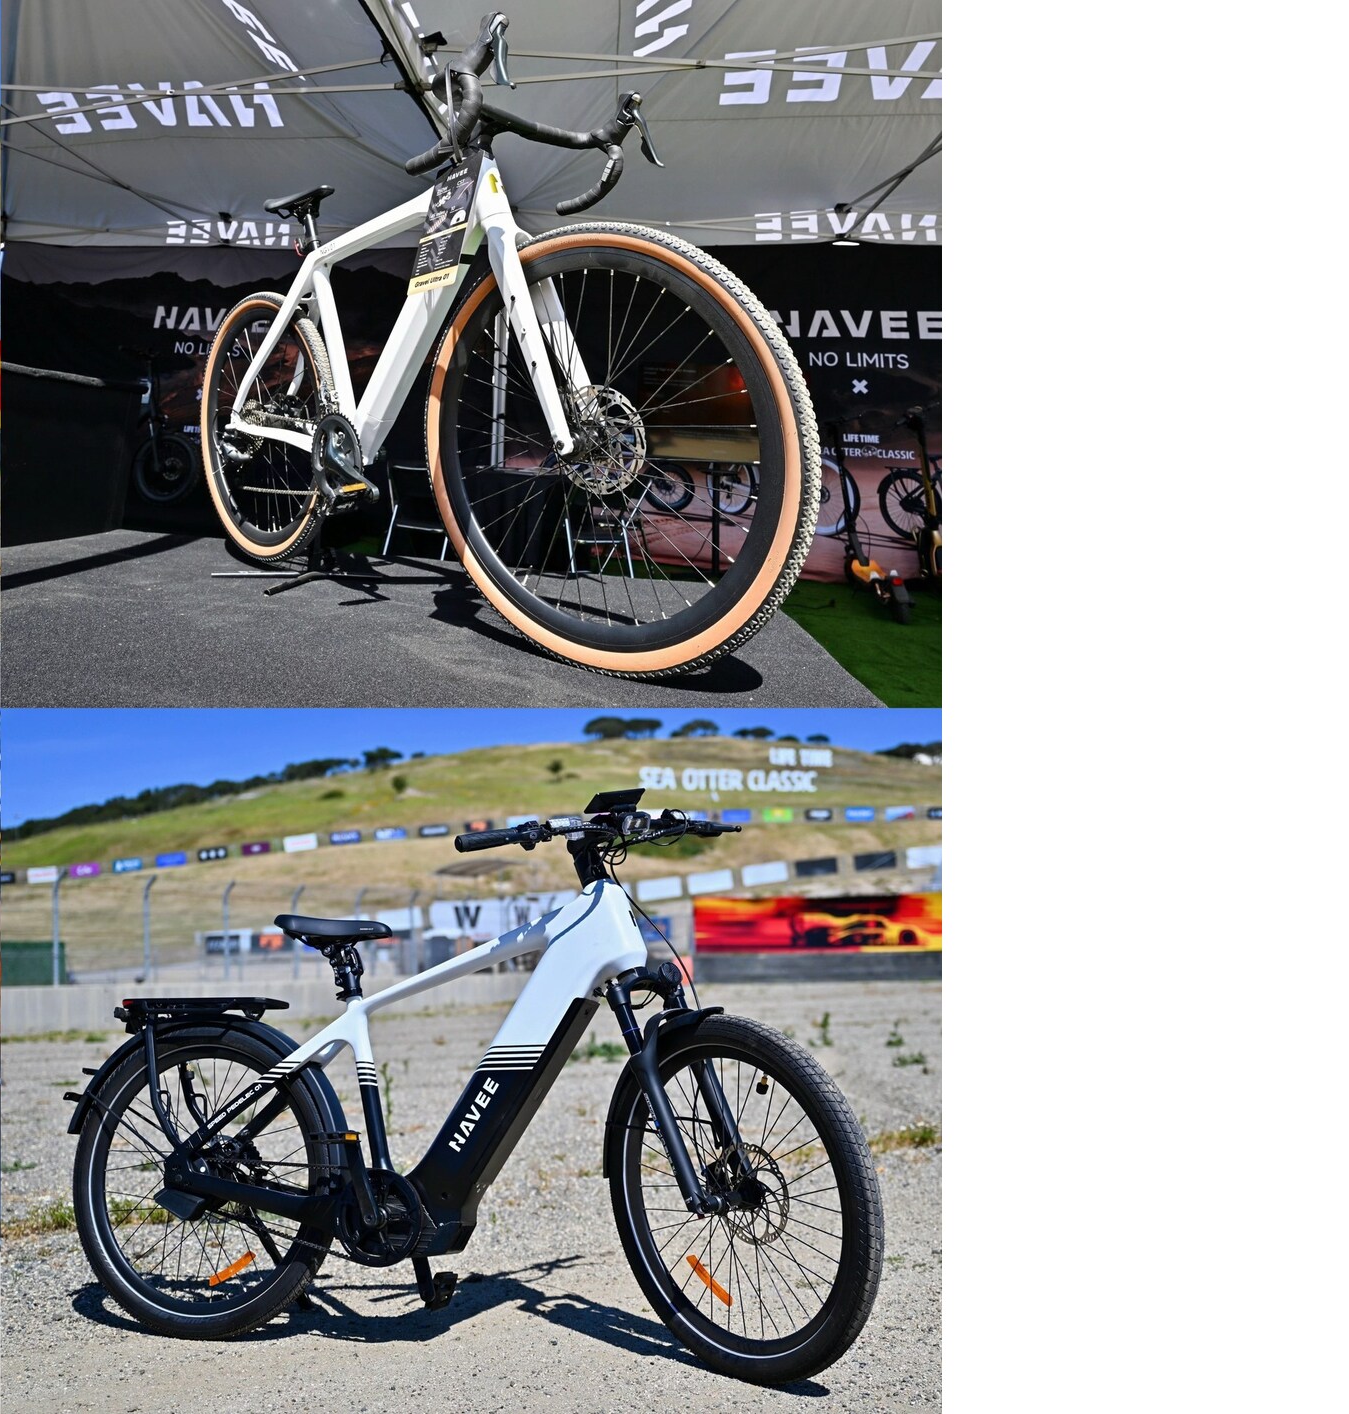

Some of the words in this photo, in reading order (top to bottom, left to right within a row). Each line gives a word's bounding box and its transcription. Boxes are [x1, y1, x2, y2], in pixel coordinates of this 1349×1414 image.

[174, 342, 194, 354] NO
[809, 351, 839, 367] NO
[846, 352, 909, 369] LIMITS
[877, 449, 915, 460] CLASSIC
[769, 747, 797, 766] LIFE
[639, 766, 677, 790] SEA
[681, 768, 744, 792] OTTER
[747, 770, 817, 793] CLASSIC
[207, 1111, 227, 1130] SPEED
[226, 1090, 254, 1114] PEDELEC
[254, 1084, 262, 1092] 01
[448, 1077, 500, 1153] NAVEE
